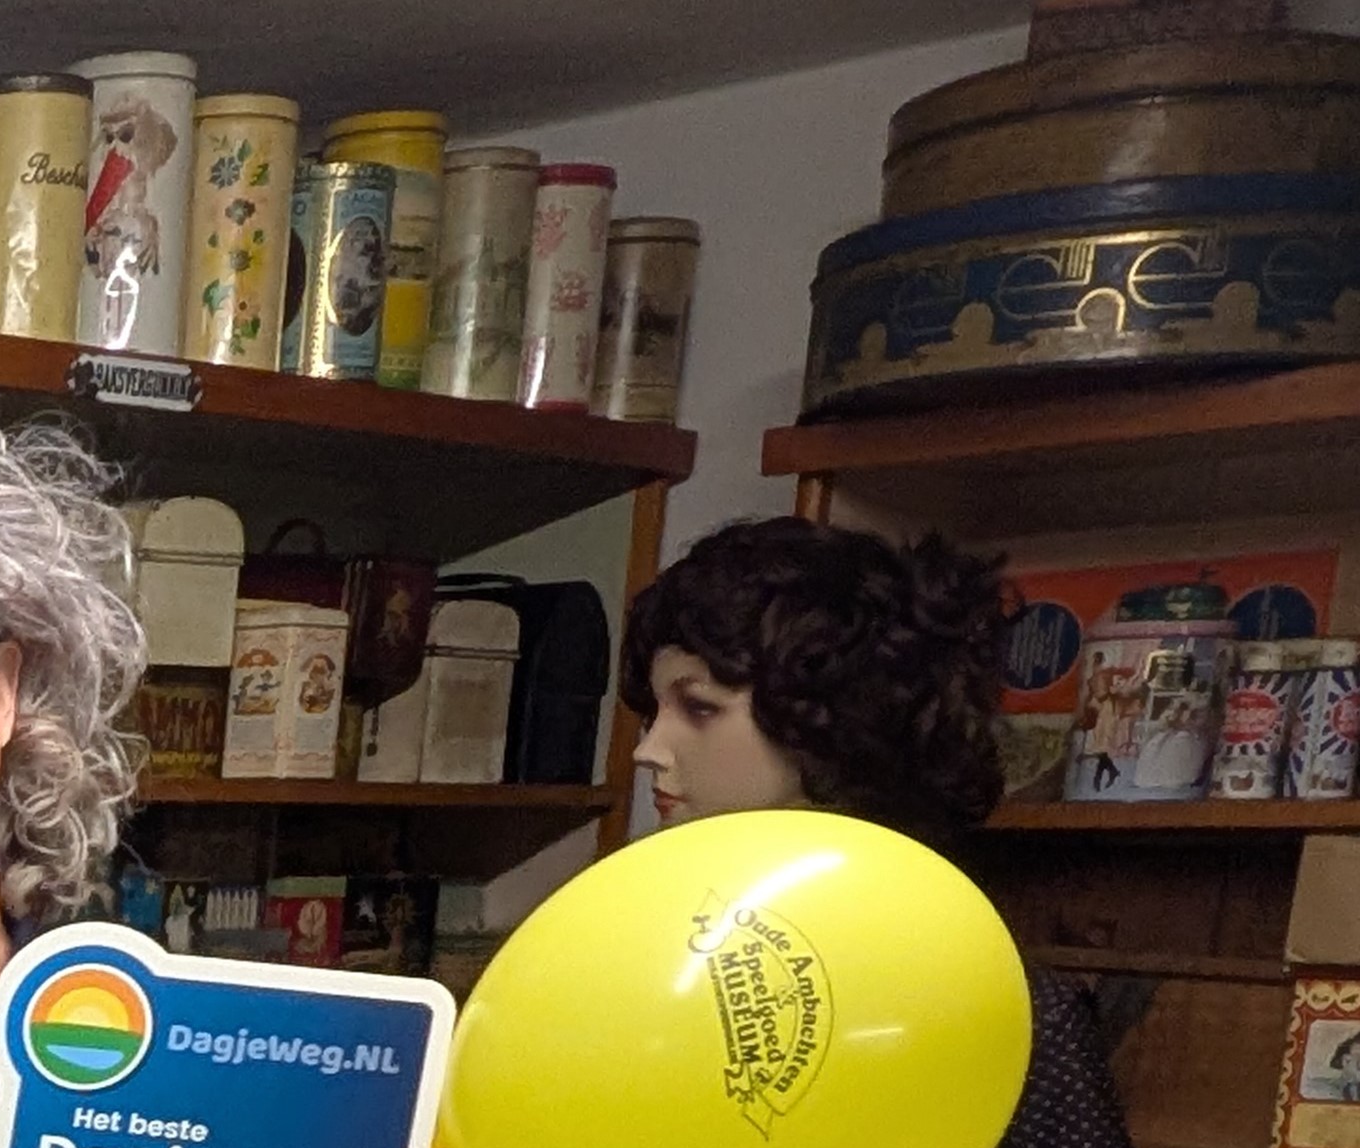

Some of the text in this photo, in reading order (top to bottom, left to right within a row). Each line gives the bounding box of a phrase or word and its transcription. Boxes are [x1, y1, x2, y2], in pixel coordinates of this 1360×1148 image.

[166, 1023, 401, 1076] DagjeWeg.NL
[718, 951, 763, 1064] MUSEUM
[734, 907, 821, 1093] Oude Ambachten
[743, 940, 787, 1063] Speelgoed
[72, 1107, 209, 1142] Het beste
